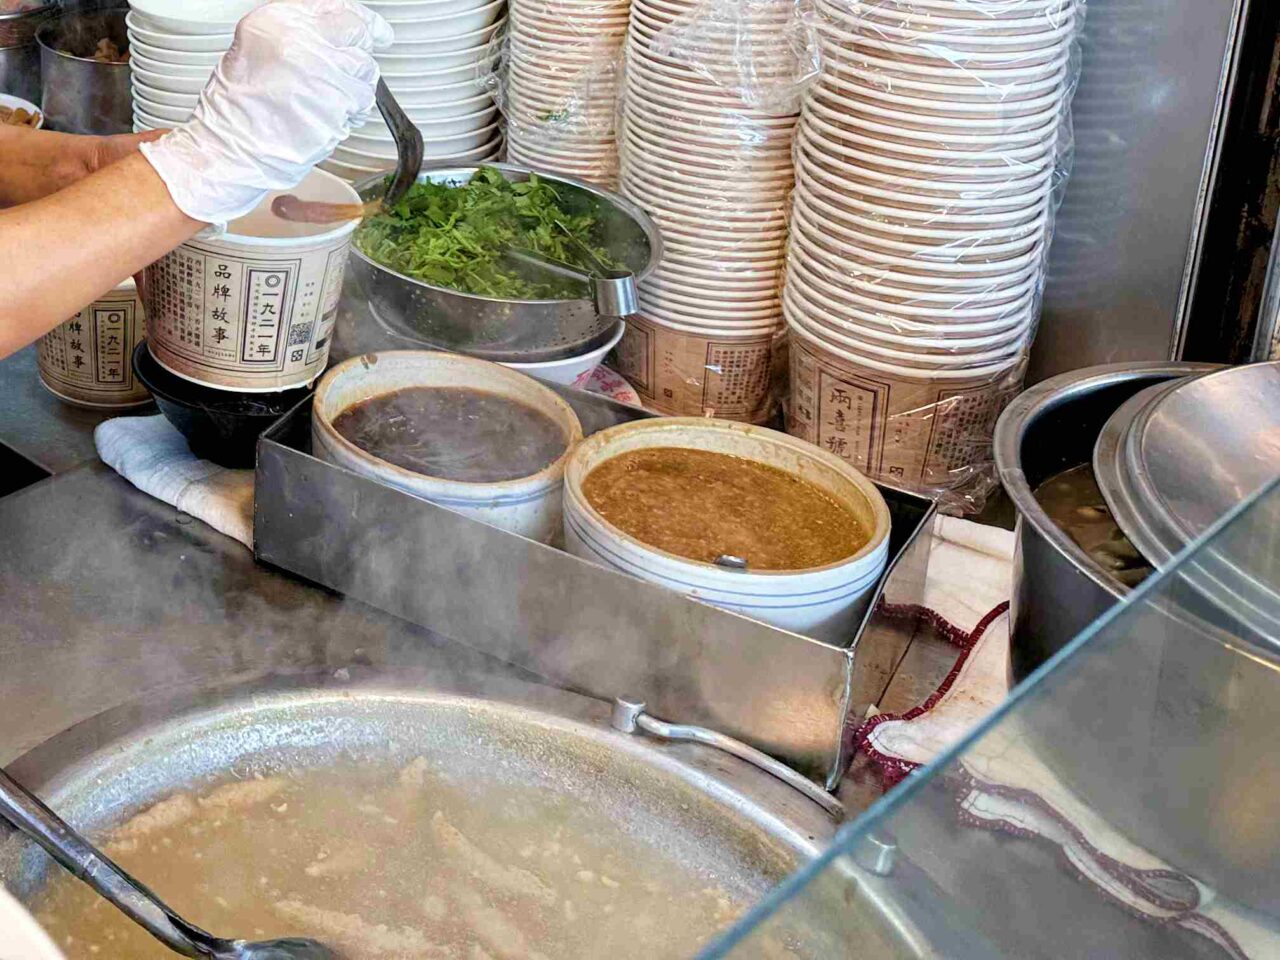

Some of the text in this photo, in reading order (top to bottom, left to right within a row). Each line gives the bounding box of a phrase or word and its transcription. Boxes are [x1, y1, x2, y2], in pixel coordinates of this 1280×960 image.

[211, 264, 232, 344] 品牌故事
[826, 388, 851, 459] 兩喜號
